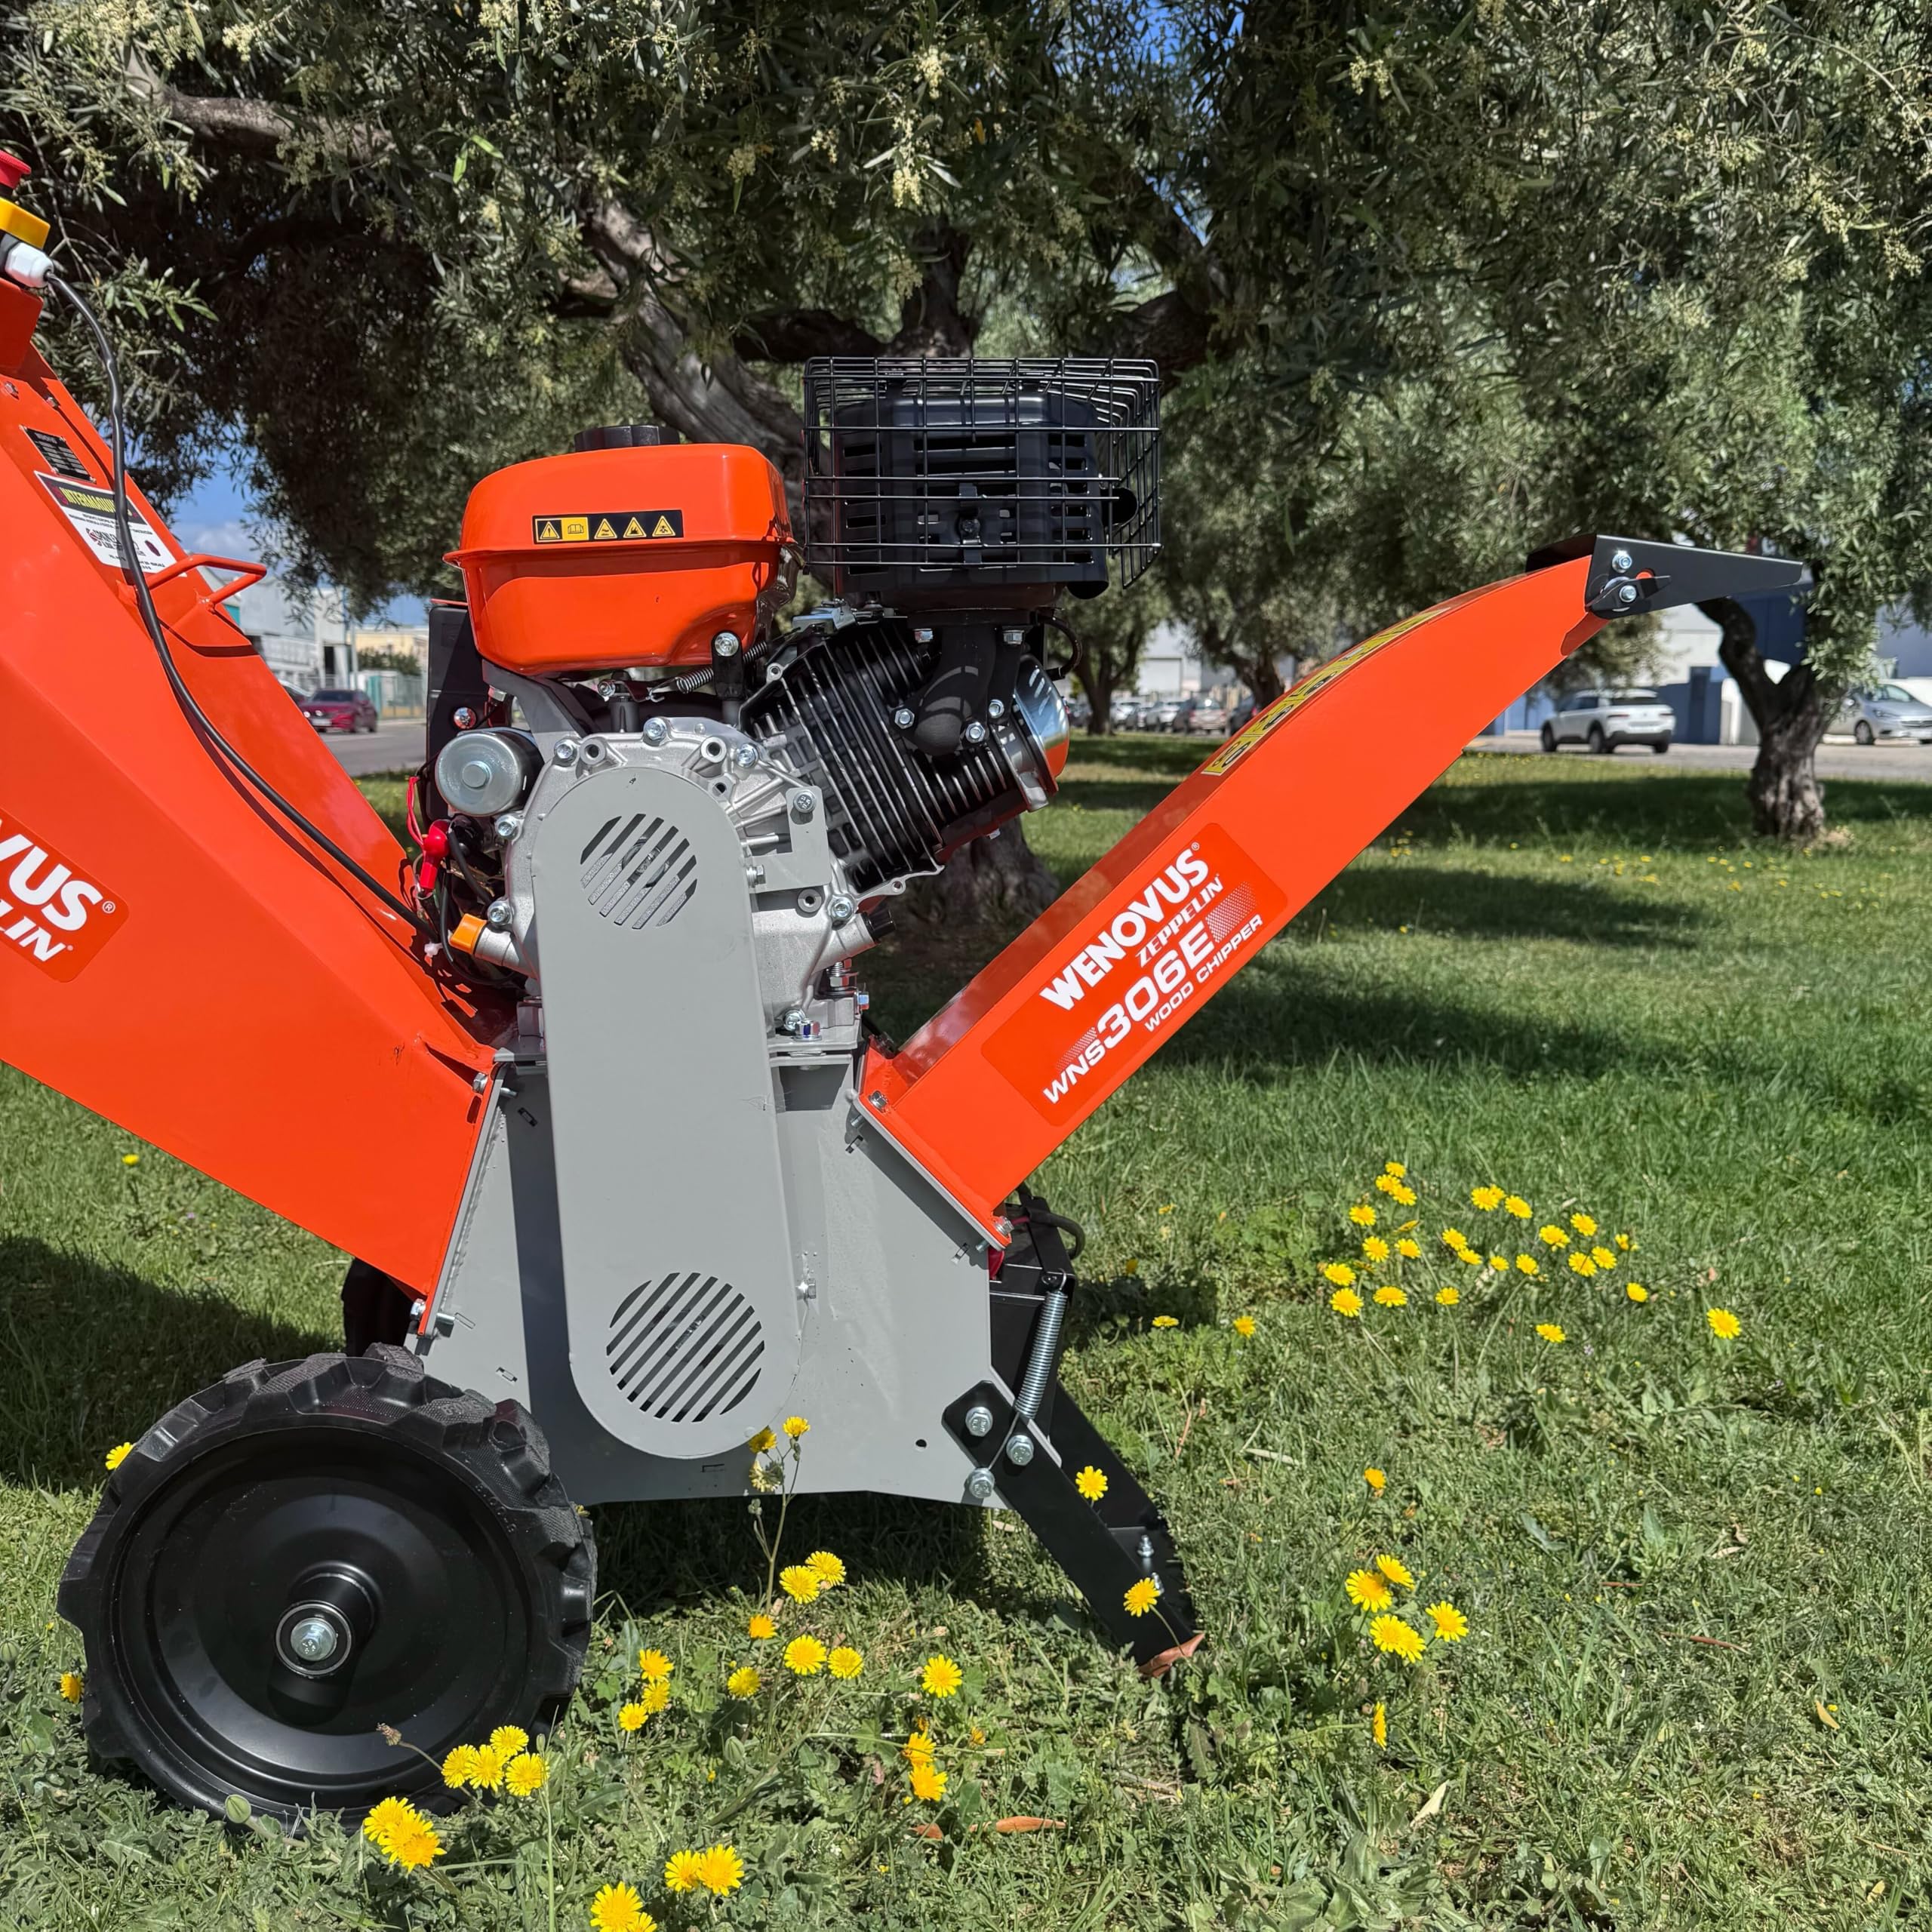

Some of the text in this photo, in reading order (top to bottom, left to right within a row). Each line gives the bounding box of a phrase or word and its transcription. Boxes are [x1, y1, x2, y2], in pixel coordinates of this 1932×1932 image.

[1039, 848, 1208, 1011] WENOVUS
[1135, 875, 1223, 968] ZEPPELIN
[1143, 914, 1263, 1032] WOOD CHIPPER
[1043, 921, 1214, 1103] WNS306E
